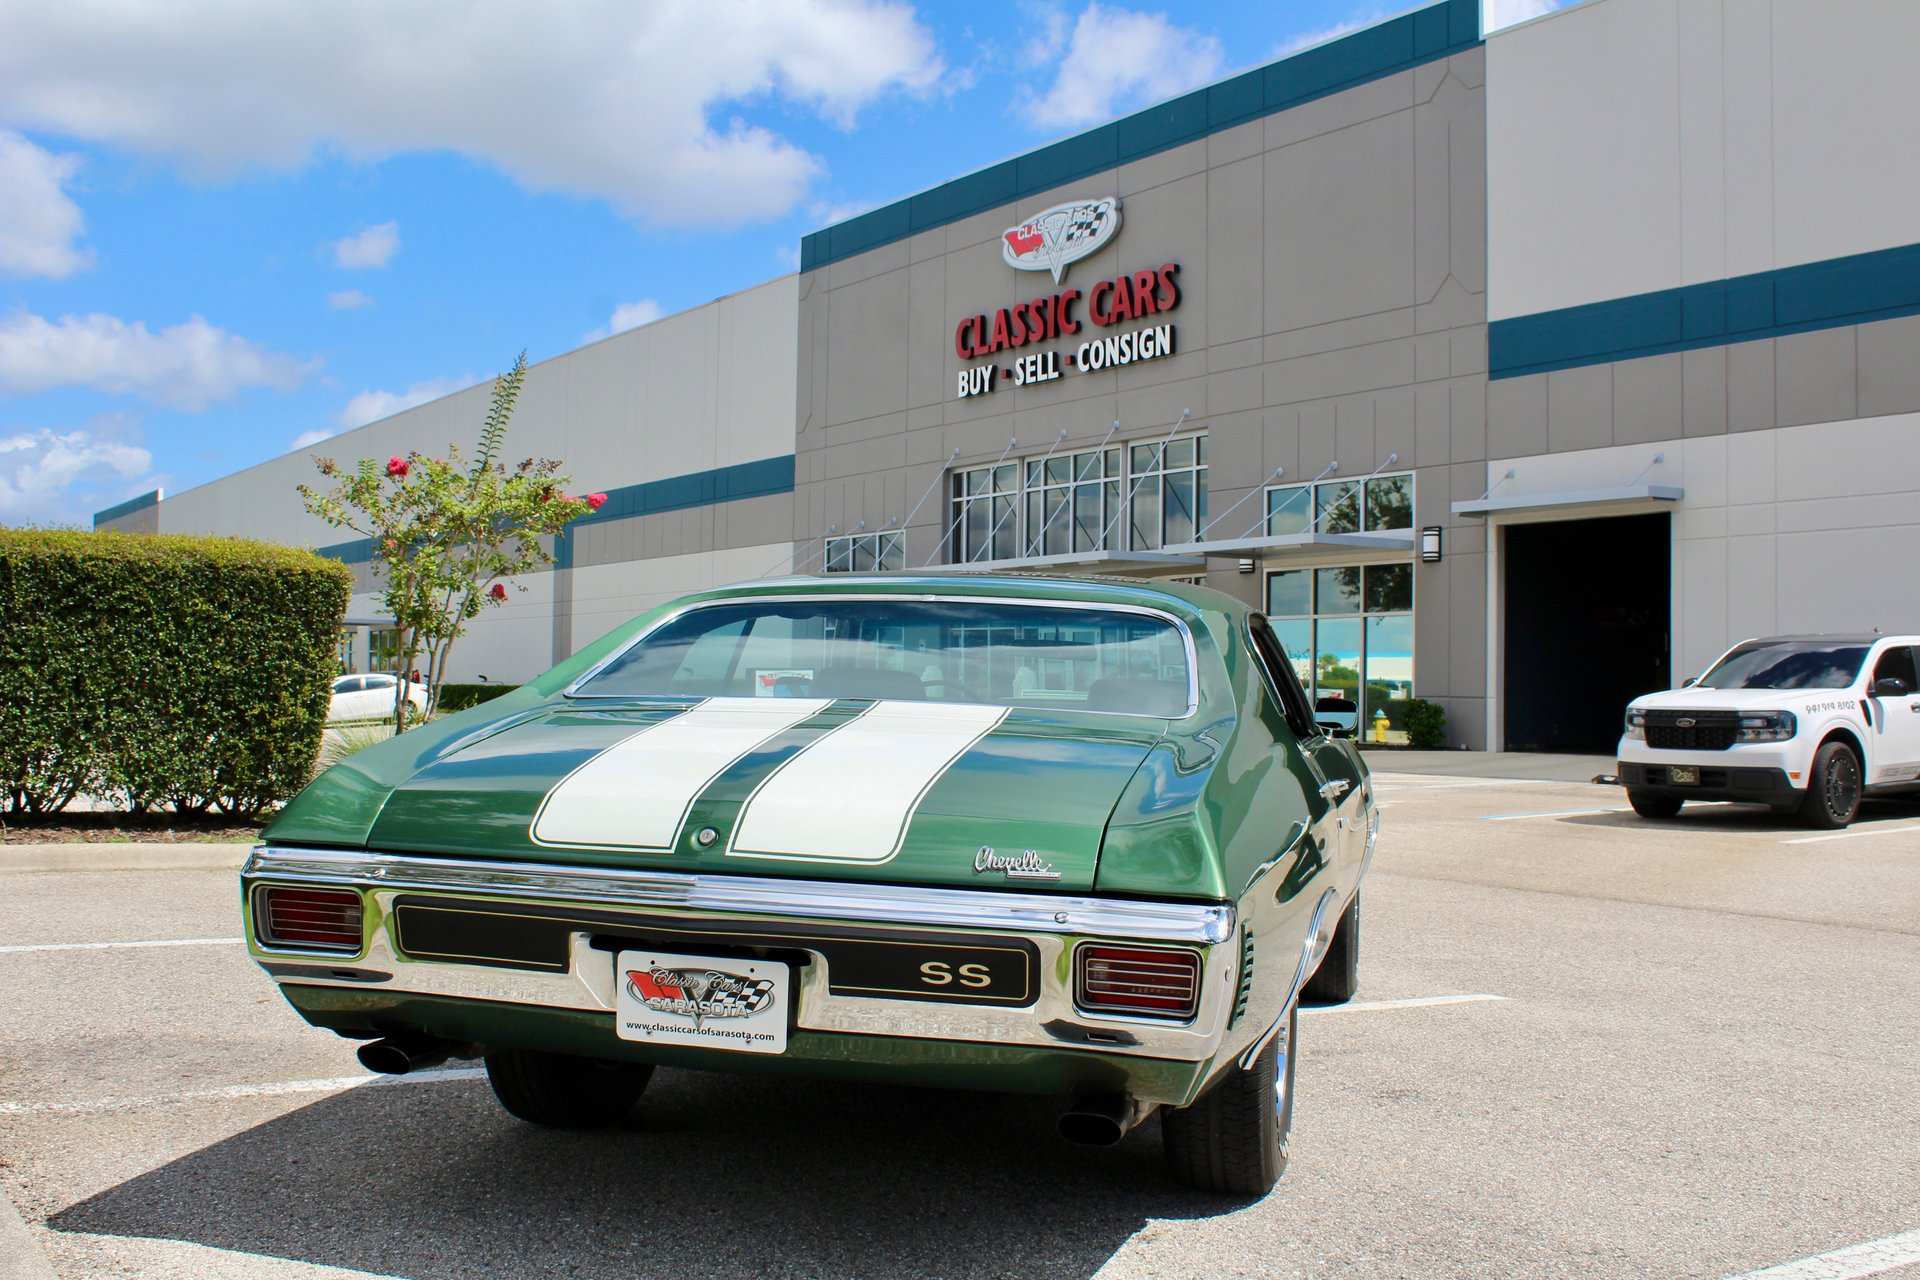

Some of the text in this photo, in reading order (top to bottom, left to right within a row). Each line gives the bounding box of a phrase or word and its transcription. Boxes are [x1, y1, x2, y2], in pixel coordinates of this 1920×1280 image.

[955, 262, 1181, 360] CLASSIC CARS
[958, 324, 1172, 398] BUY SELL CONSIGN
[975, 845, 1052, 873] Chevelle
[649, 966, 747, 993] Classic Cars
[920, 961, 992, 988] SS
[649, 996, 750, 1019] SARASOTA
[626, 1021, 775, 1042] www.classiccarsofsarasota.com
